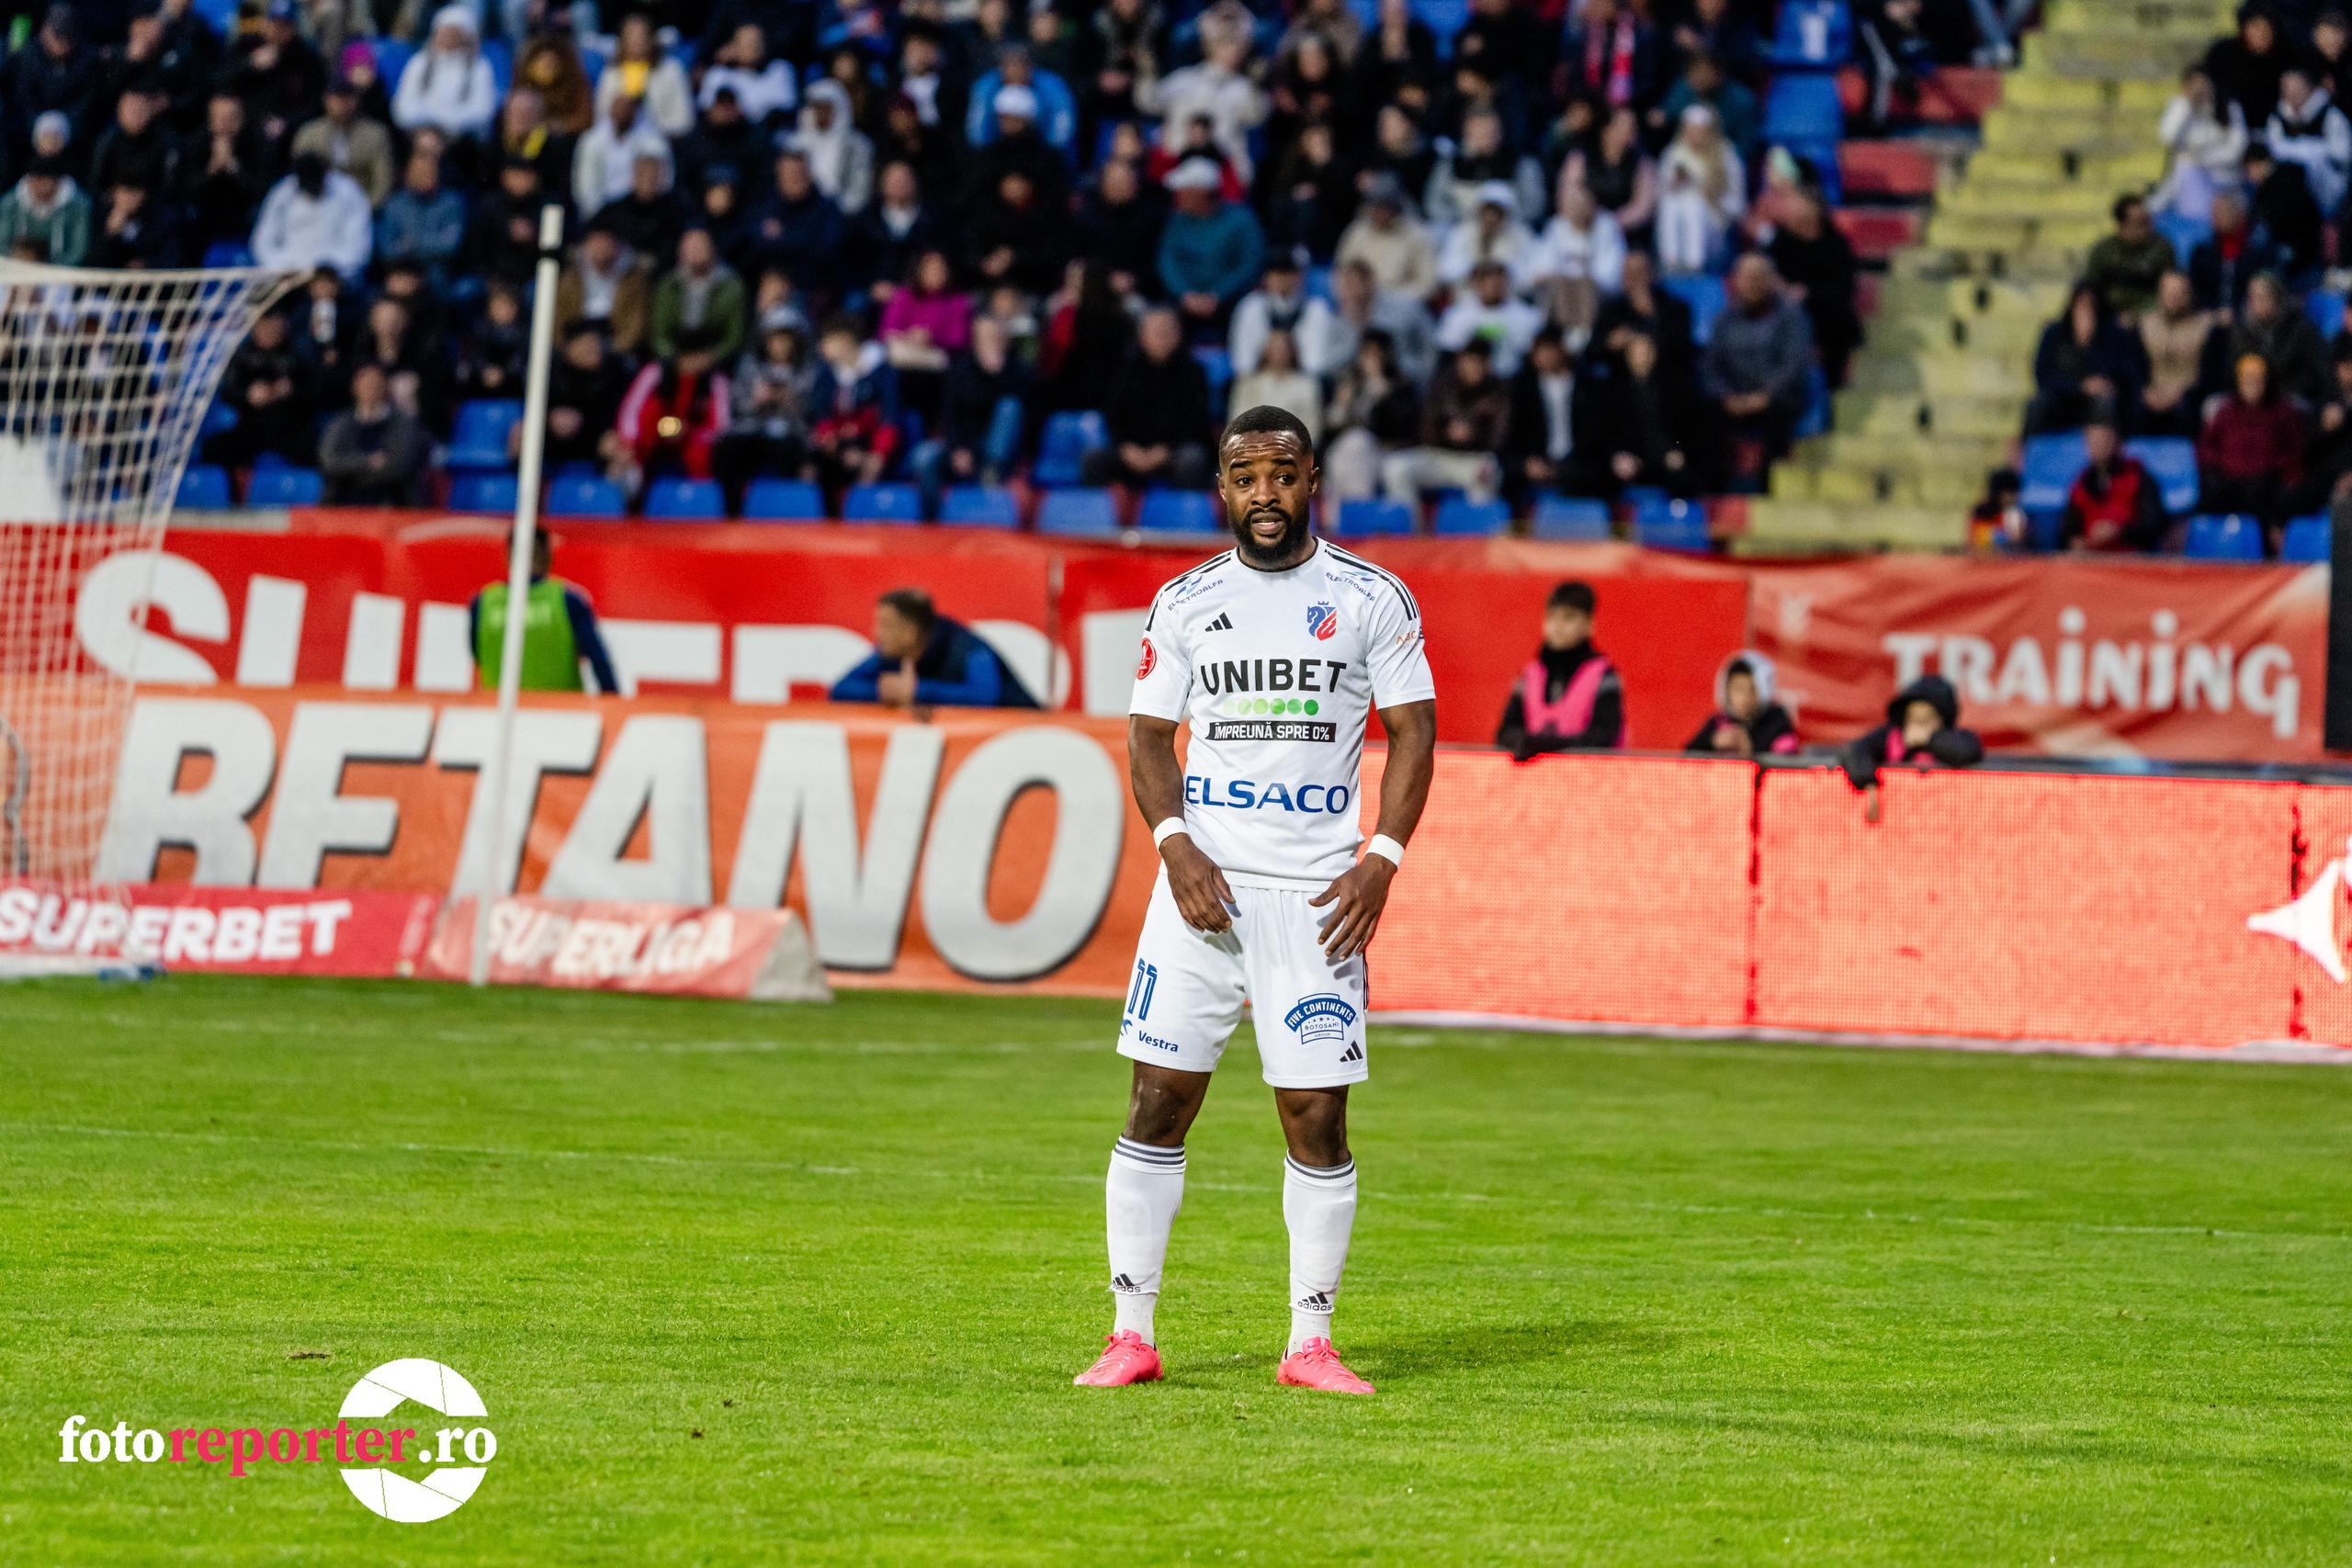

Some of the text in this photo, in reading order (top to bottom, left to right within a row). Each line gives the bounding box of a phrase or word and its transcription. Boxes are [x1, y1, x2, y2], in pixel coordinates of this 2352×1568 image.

[1168, 579, 1224, 611] ELECTROALFA
[1326, 571, 1375, 602] ELECTROALFA
[1201, 659, 1347, 695] UNIBET
[1215, 721, 1329, 740] ÎMPREUNĂ SPRE 0%
[1185, 776, 1349, 814] ELSACO
[0, 887, 352, 963] SUPERBET
[490, 902, 734, 977] SUPERLIGA
[1127, 957, 1158, 1021] 11
[1287, 1001, 1353, 1028] FIVE CONTINENTS
[1305, 1021, 1339, 1031] BOTOSANI
[1139, 1030, 1179, 1053] Vestra
[1297, 1300, 1332, 1311] adidas
